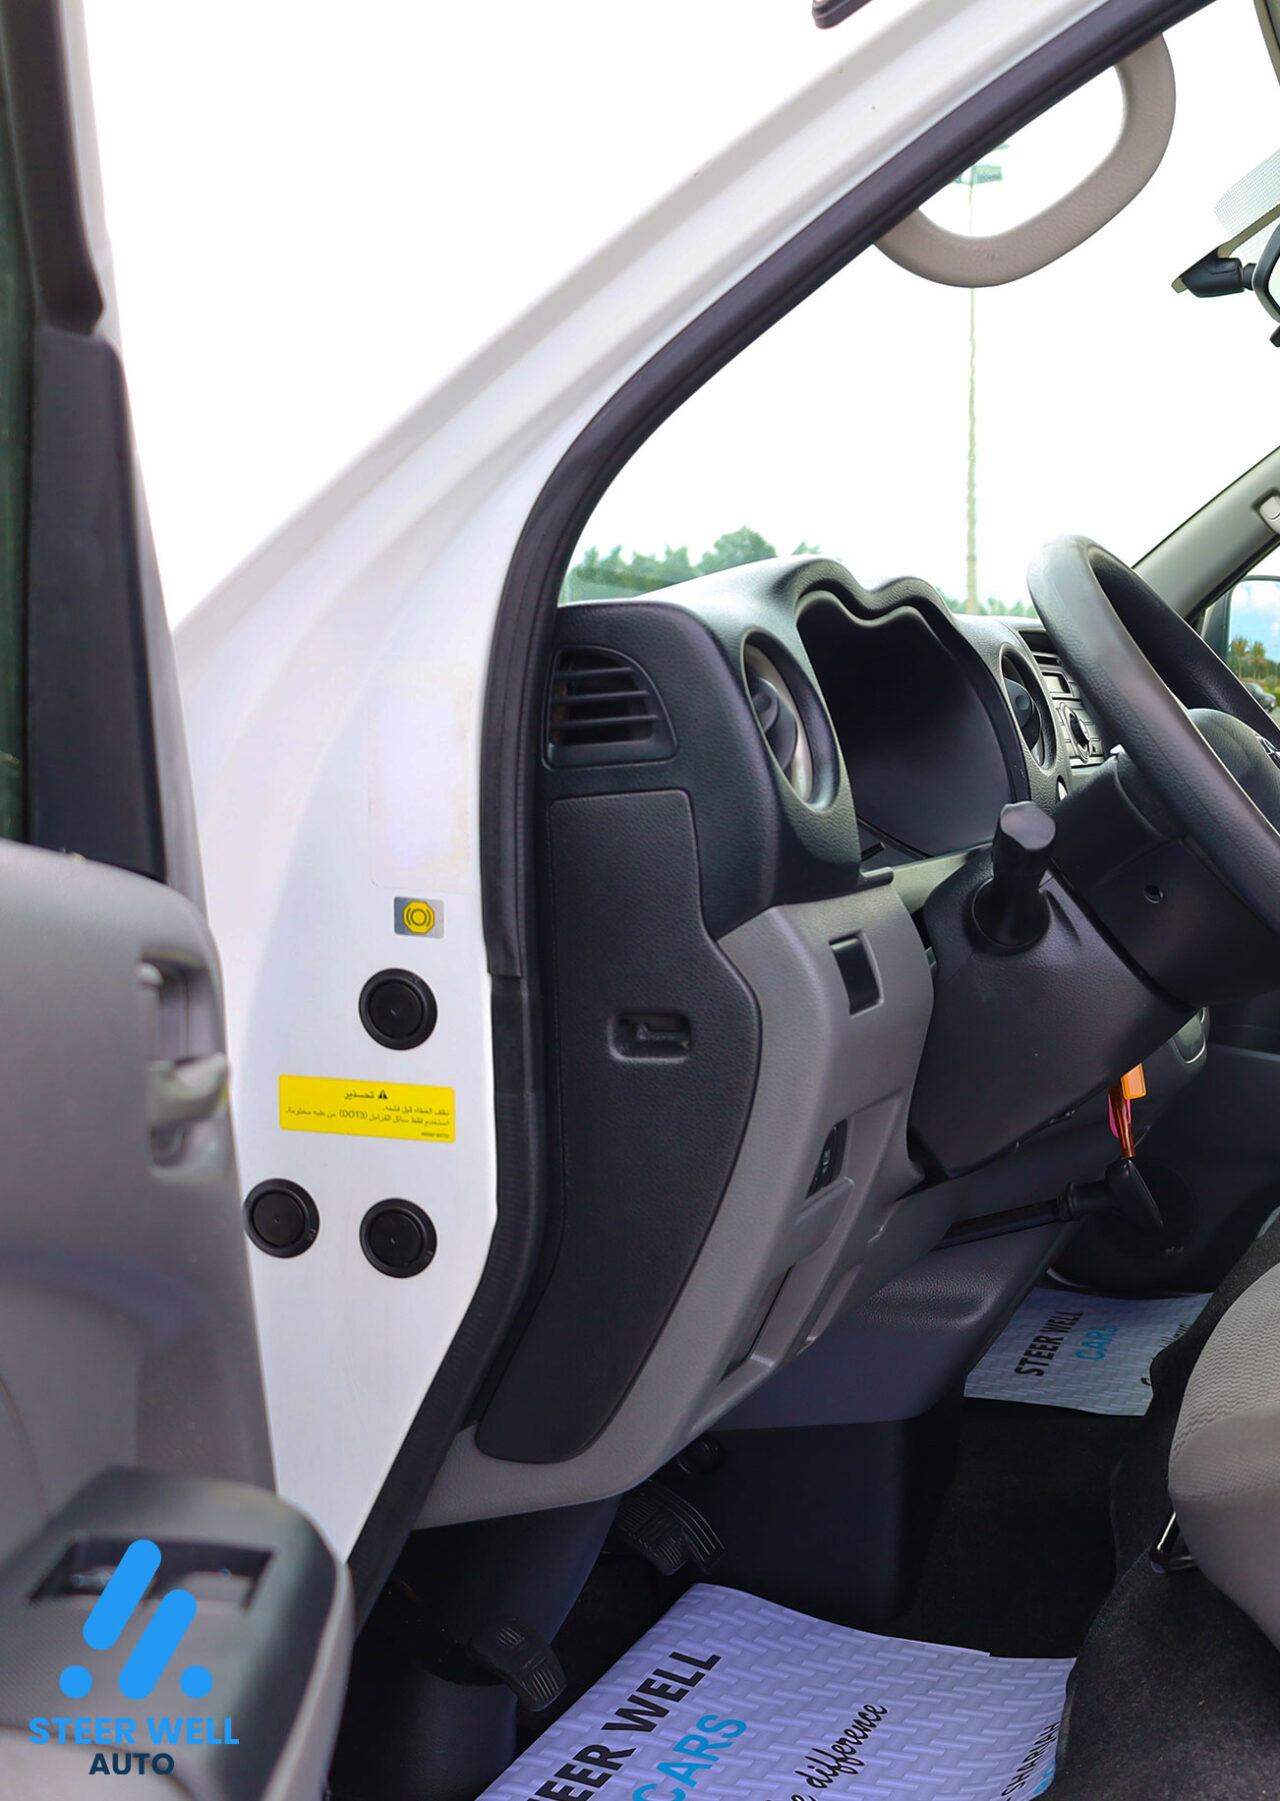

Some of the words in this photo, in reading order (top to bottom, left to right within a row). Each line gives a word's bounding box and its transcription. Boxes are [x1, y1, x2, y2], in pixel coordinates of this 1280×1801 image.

[1014, 1335, 1064, 1376] STEER
[1040, 1311, 1084, 1333] WELL
[1075, 1325, 1119, 1360] CARS
[601, 1651, 722, 1733] WELL
[794, 1704, 888, 1789] difference
